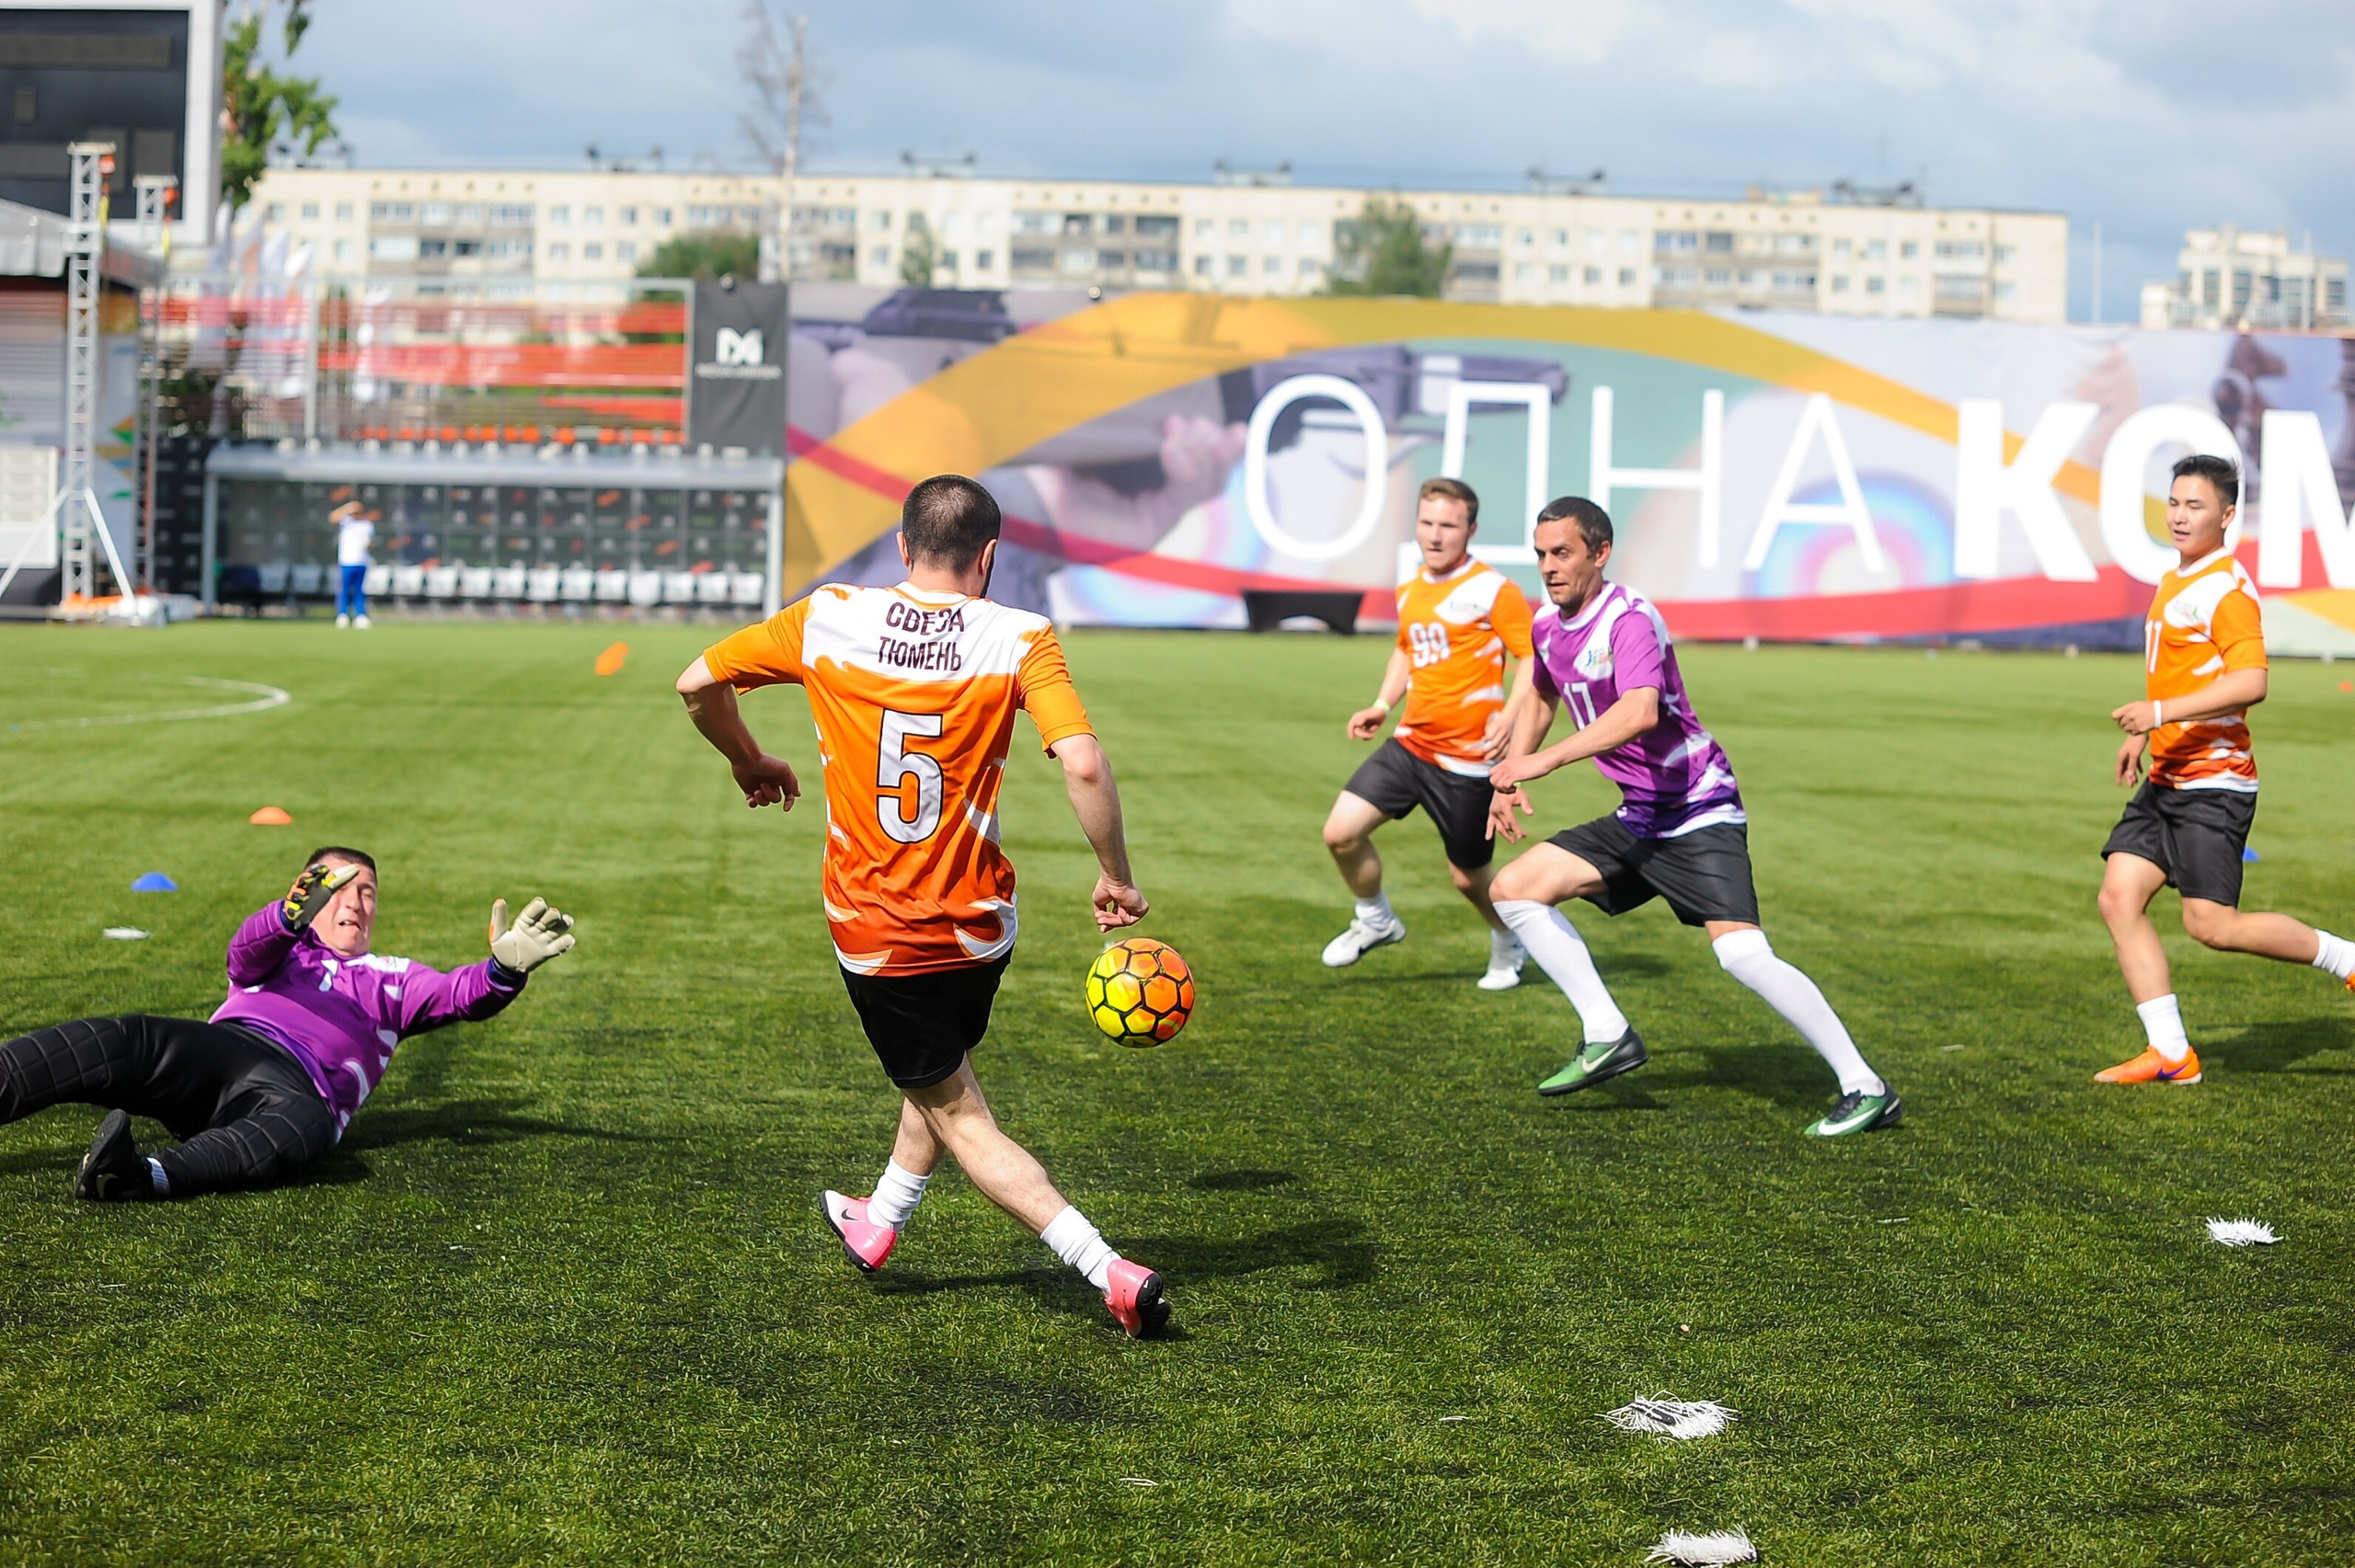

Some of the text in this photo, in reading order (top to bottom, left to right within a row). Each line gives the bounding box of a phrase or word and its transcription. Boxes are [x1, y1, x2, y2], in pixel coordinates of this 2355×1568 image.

[1245, 373, 1885, 603] ОДНА
[885, 601, 965, 636] СВЕЗА
[877, 635, 962, 672] ТЮМЕНЬ
[1408, 621, 1451, 669] 99
[1563, 681, 1597, 732] 17
[876, 706, 945, 845] 5
